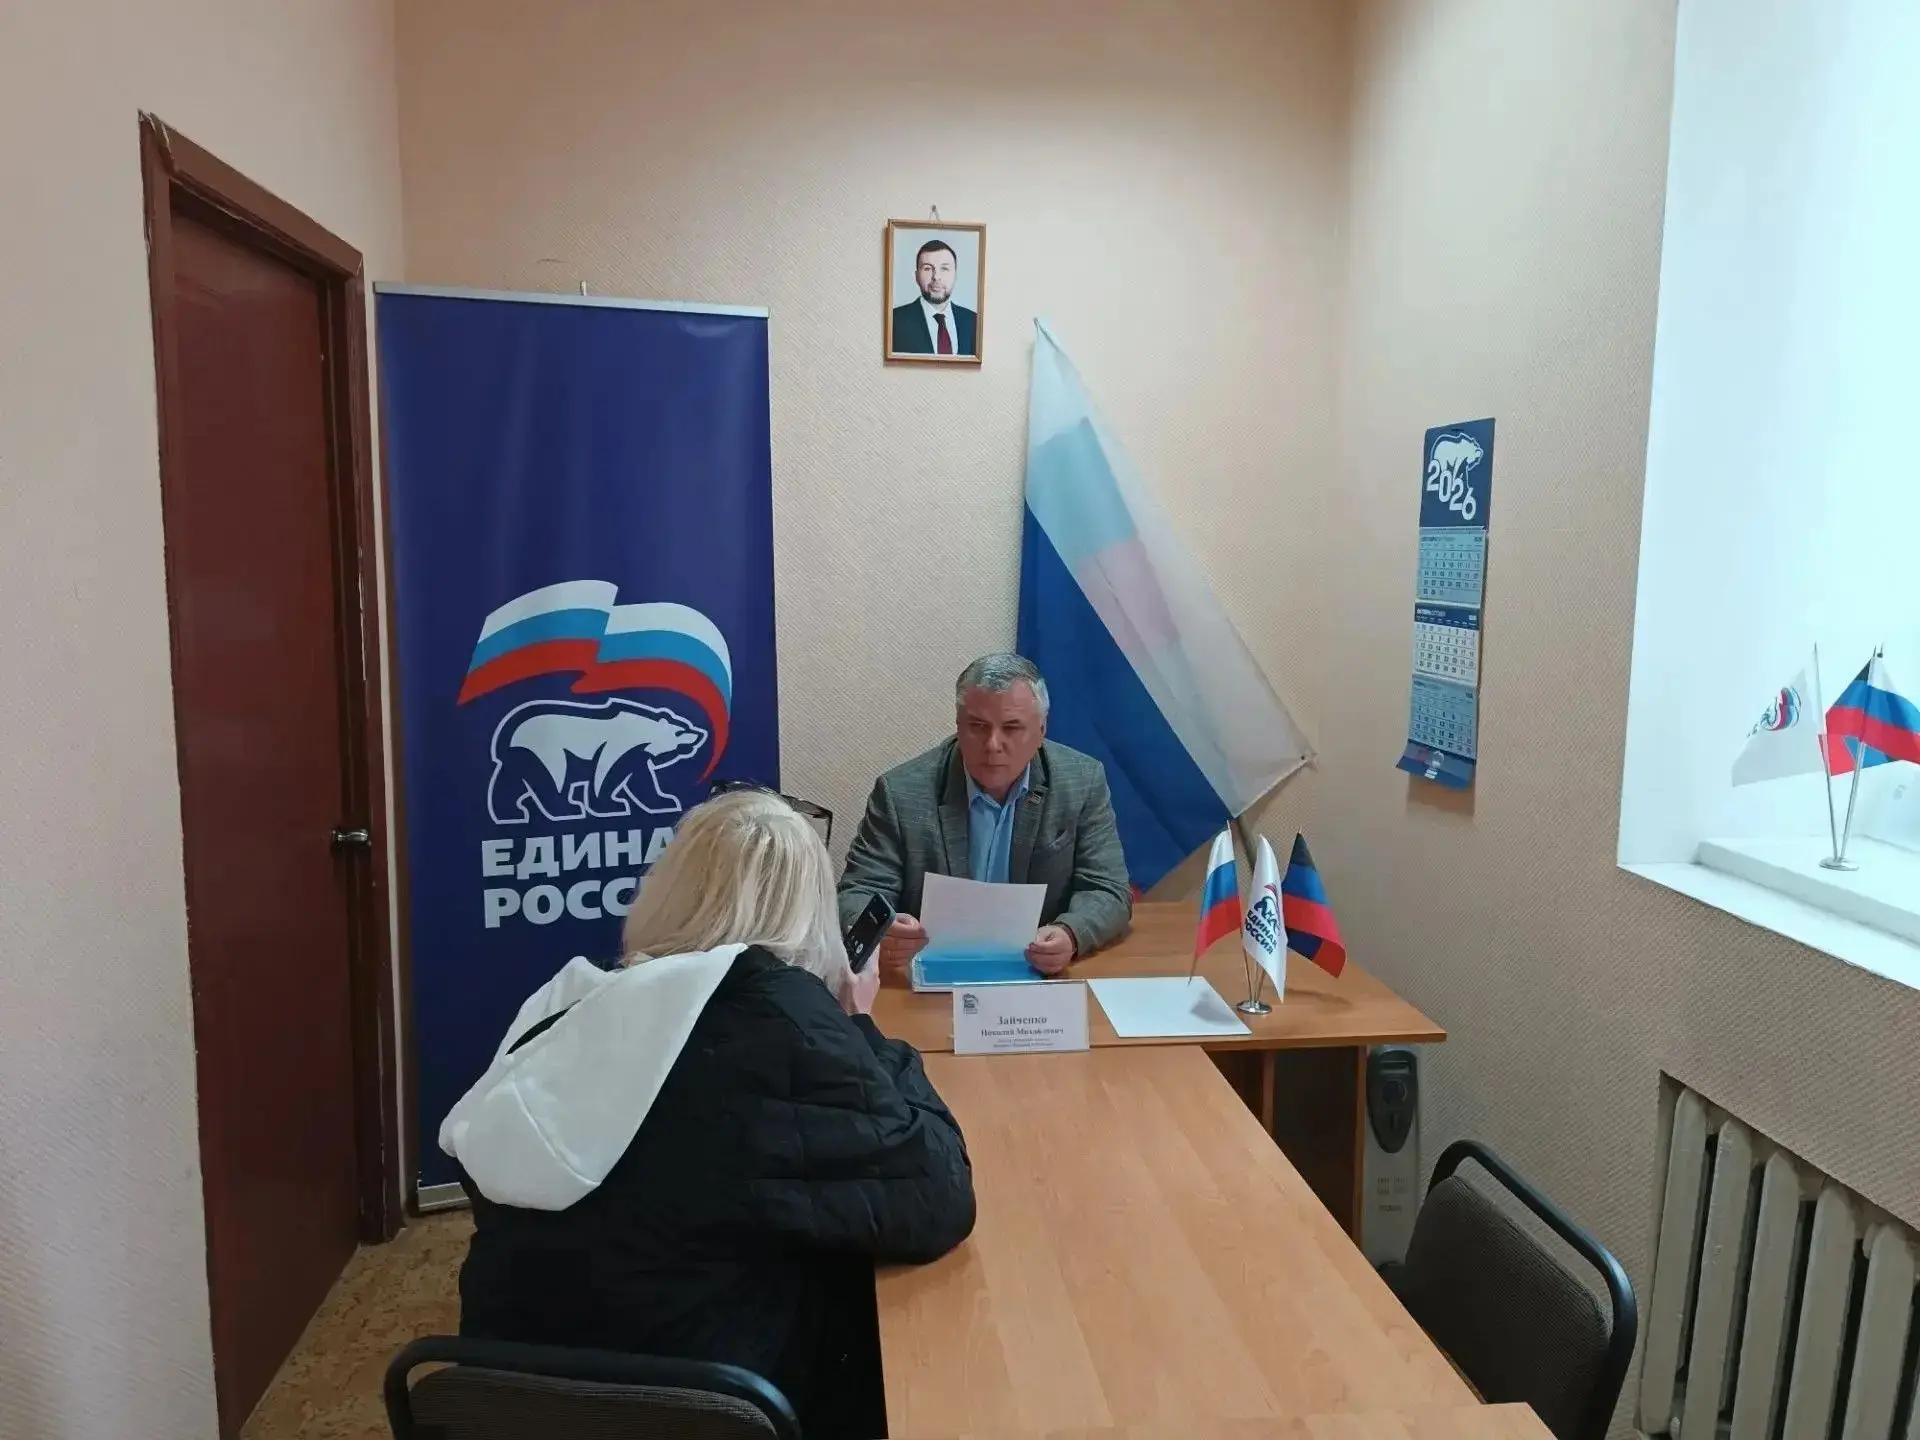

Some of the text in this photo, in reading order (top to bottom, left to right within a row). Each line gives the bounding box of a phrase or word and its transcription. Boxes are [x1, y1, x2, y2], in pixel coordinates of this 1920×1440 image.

[1426, 459, 1477, 521] 2026
[482, 827, 677, 880] ЕДИНА
[484, 876, 650, 928] РОСС
